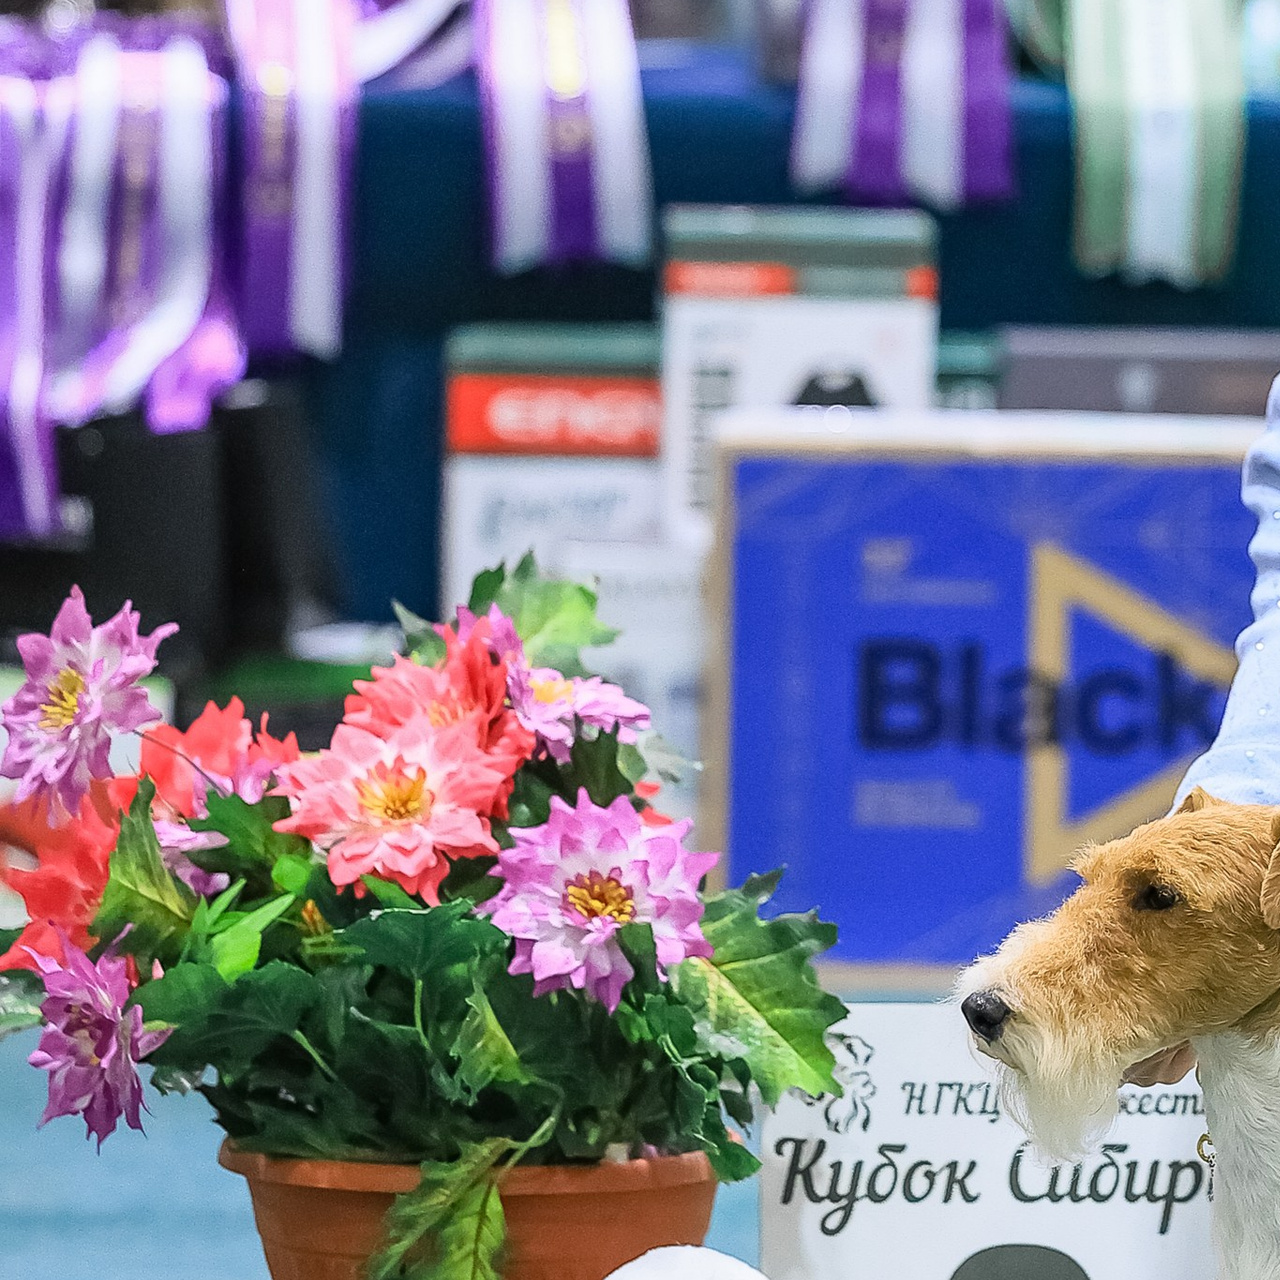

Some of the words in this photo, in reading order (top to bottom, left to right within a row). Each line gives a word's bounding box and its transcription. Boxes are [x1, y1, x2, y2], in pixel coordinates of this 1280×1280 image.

[901, 1081, 999, 1123] НГКЦ
[774, 1136, 981, 1236] Кубок
[1008, 1140, 1204, 1236] Сибир
